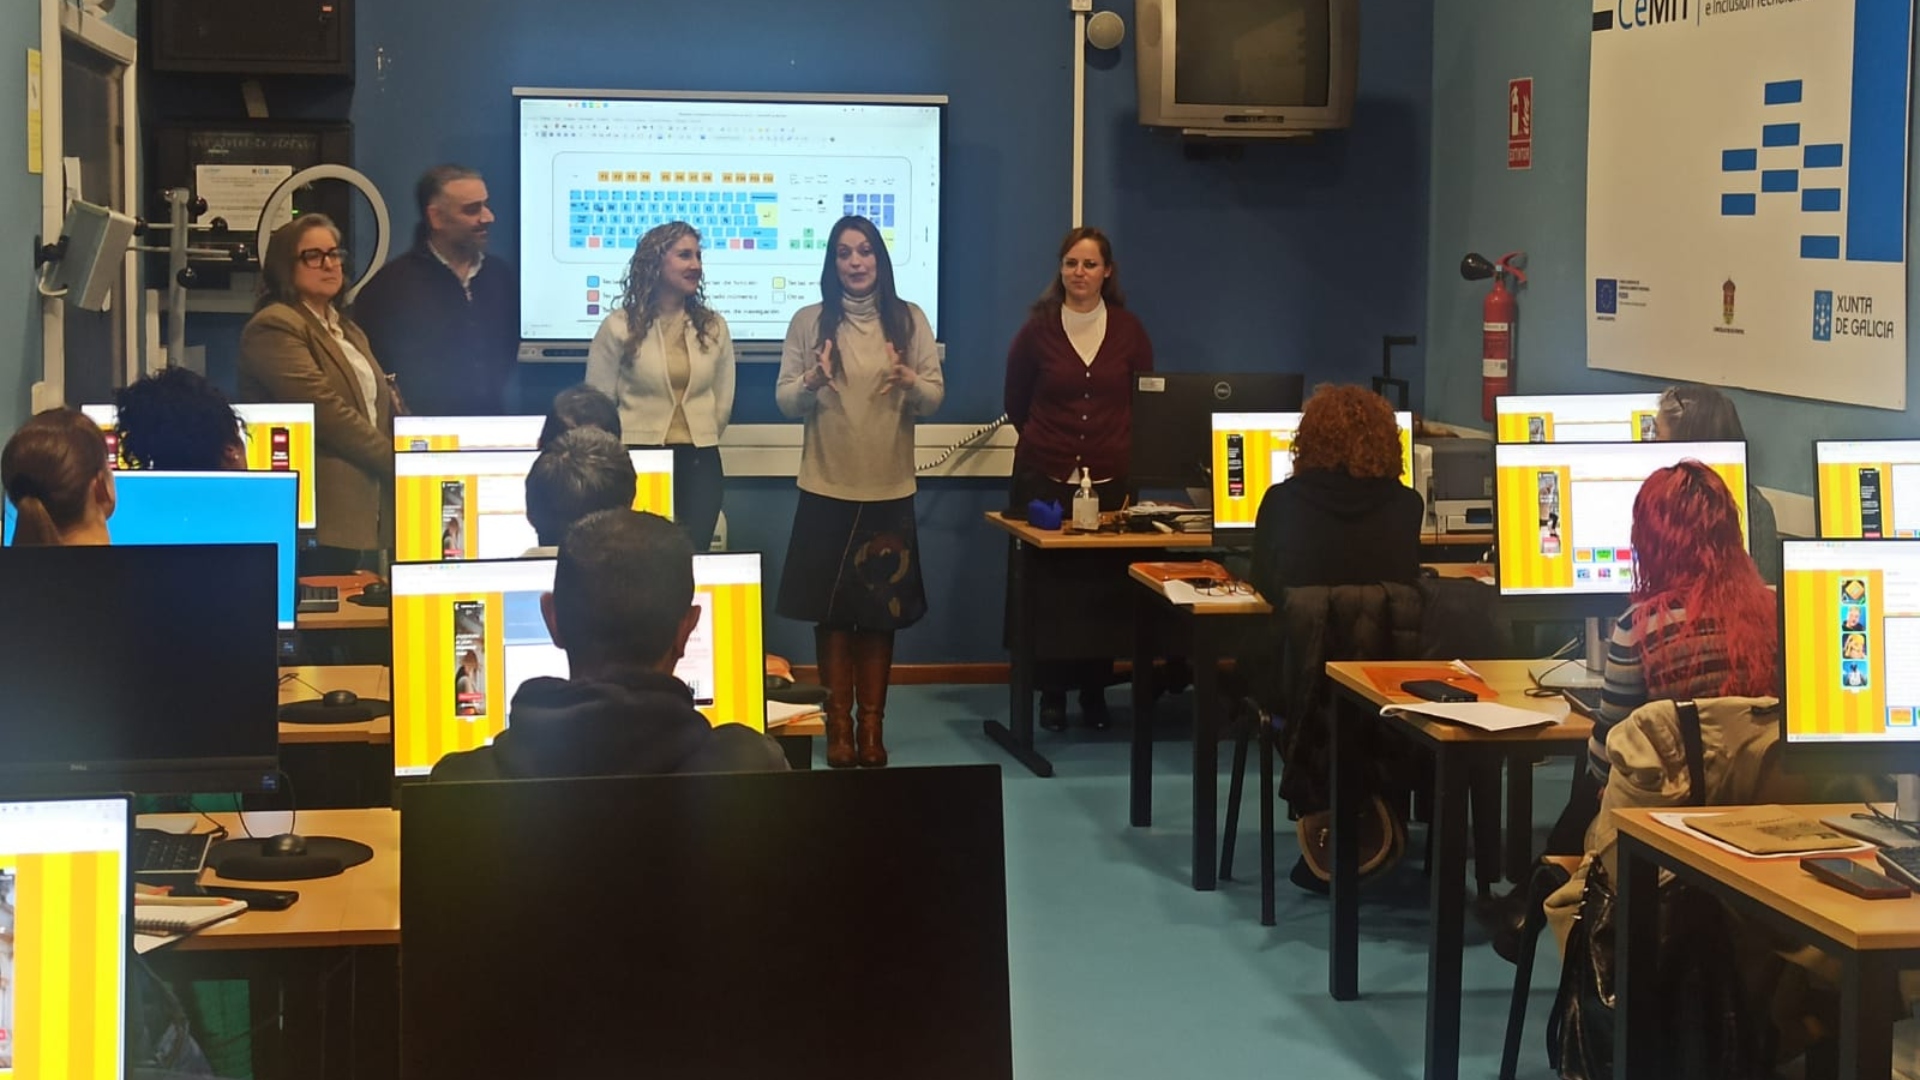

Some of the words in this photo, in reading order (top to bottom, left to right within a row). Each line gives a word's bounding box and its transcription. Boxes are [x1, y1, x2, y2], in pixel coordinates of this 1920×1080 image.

[1704, 2, 1711, 16] e
[1836, 295, 1873, 314] XUNTA
[1835, 317, 1848, 335] DE
[1851, 318, 1894, 338] GALICIA
